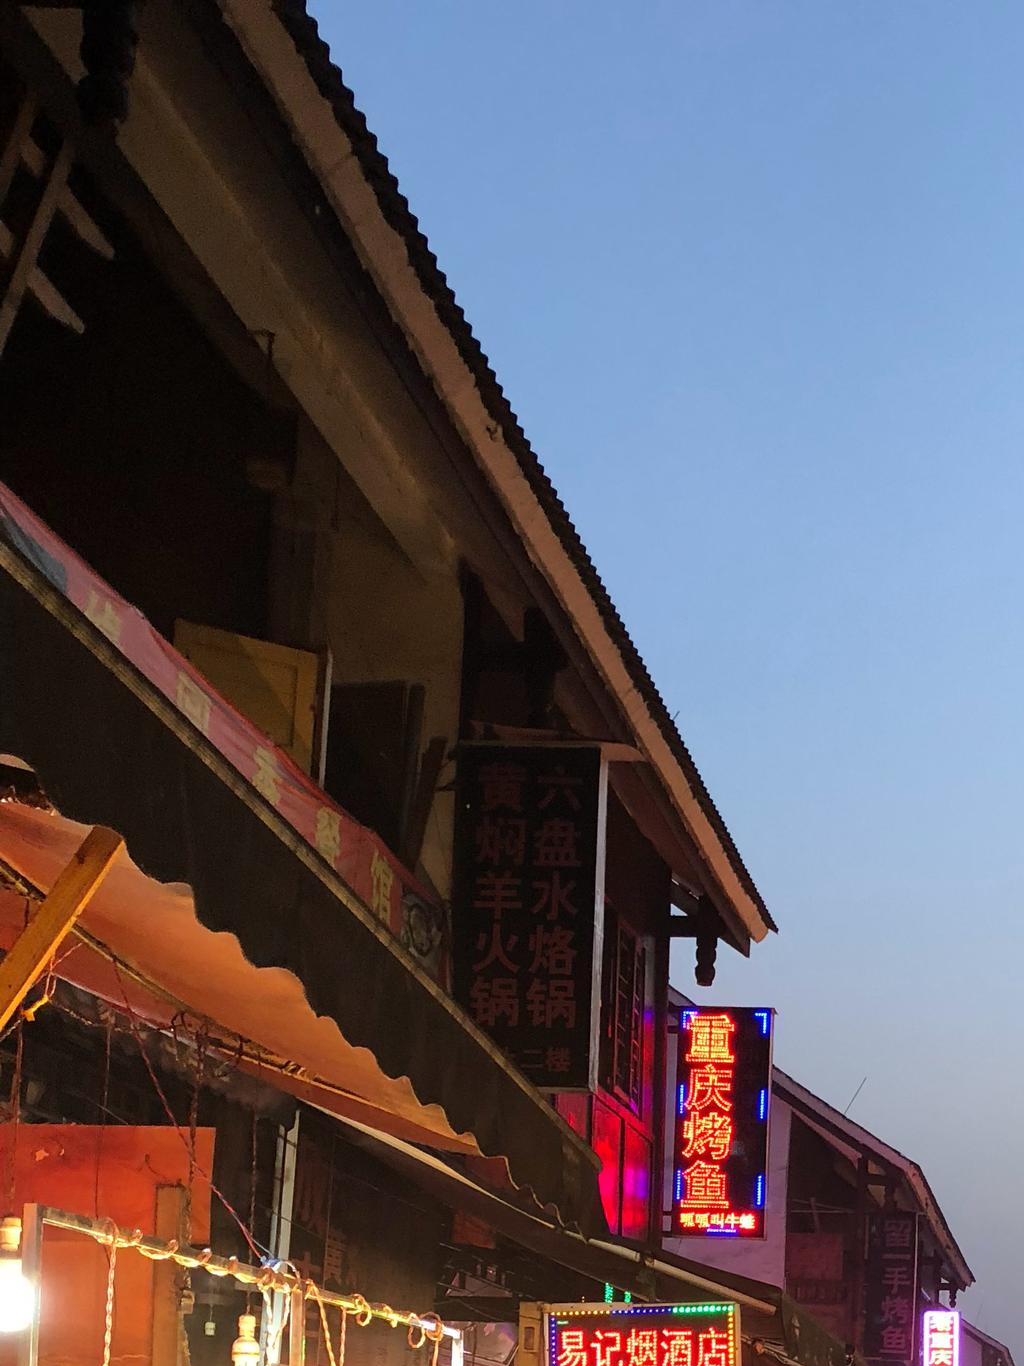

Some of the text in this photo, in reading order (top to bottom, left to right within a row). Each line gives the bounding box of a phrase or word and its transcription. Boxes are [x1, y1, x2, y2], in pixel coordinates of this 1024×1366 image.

[525, 764, 583, 1030] 六盘水烙锅
[500, 1044, 572, 1074] 二楼
[680, 1014, 736, 1209] 重庆烤鱼
[880, 1219, 913, 1356] 留一手烤鱼
